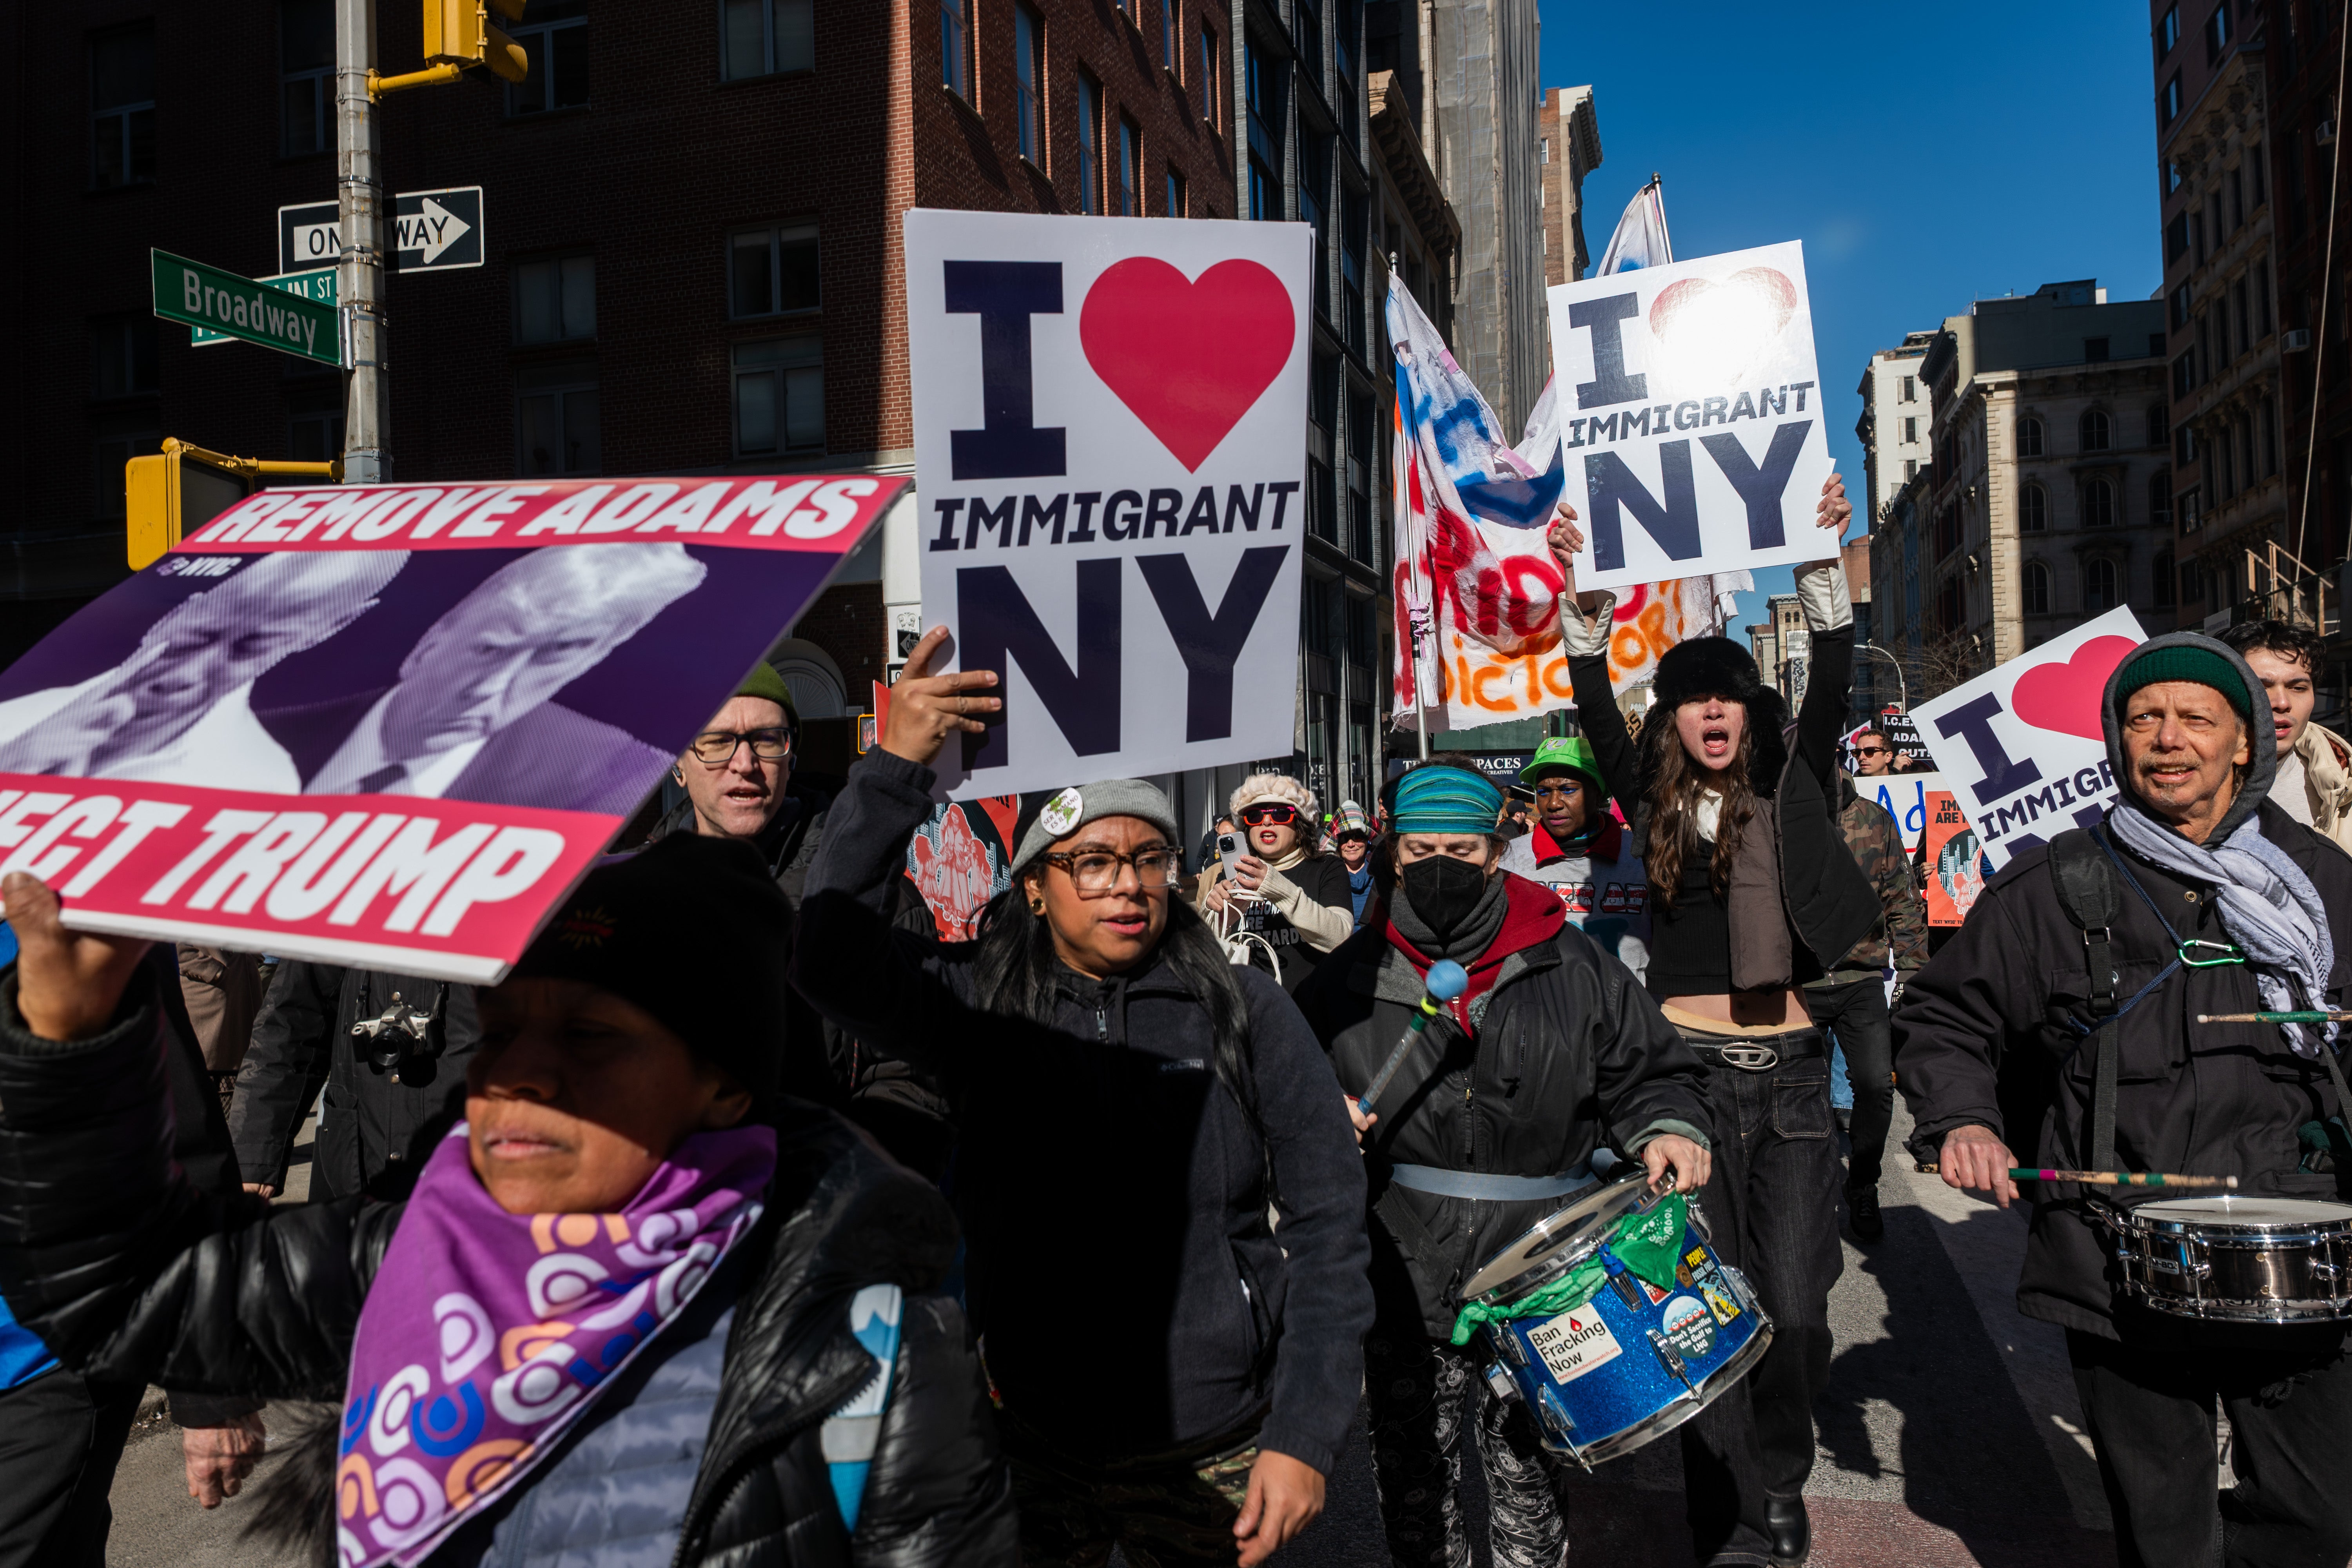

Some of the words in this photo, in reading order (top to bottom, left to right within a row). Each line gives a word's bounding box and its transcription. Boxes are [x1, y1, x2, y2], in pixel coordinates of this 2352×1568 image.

[317, 276, 331, 299] ST
[183, 268, 316, 356] Broadway
[1568, 292, 1648, 410] I
[943, 260, 1066, 480] I
[1568, 381, 1814, 448] IMMIGRANT
[196, 482, 534, 543] REMOVE
[524, 478, 880, 539] ADAMS
[1583, 420, 1813, 572] NY
[929, 481, 1301, 552] IMMIGRANT
[956, 544, 1290, 771] NY
[1893, 733, 1923, 742] ADA
[1934, 691, 2042, 806] I
[1044, 815, 1054, 826] SER
[1055, 795, 1078, 816] HUMANO
[1051, 820, 1058, 829] ES
[1059, 806, 1077, 822] ILEGAL
[1935, 812, 1959, 824] ARE
[0, 789, 193, 898] ECT
[142, 808, 564, 938] TRUMP
[1238, 916, 1264, 931] ARE
[1168, 1062, 1200, 1070] Columbia
[1686, 1246, 1706, 1267] PEOPLE
[1691, 1267, 1707, 1282] FOSSIL
[1704, 1259, 1715, 1272] FUELS
[1532, 1327, 1561, 1347] Ban
[1539, 1321, 1606, 1361] Fracking
[1669, 1330, 1687, 1344] Don't
[1688, 1316, 1712, 1334] Sacrifice
[1679, 1339, 1692, 1349] the
[1691, 1330, 1705, 1343] Gulf
[1692, 1339, 1709, 1352] LNG
[1548, 1352, 1583, 1374] Now
[1558, 1347, 1618, 1380] www.foodandwaterwatch.org
